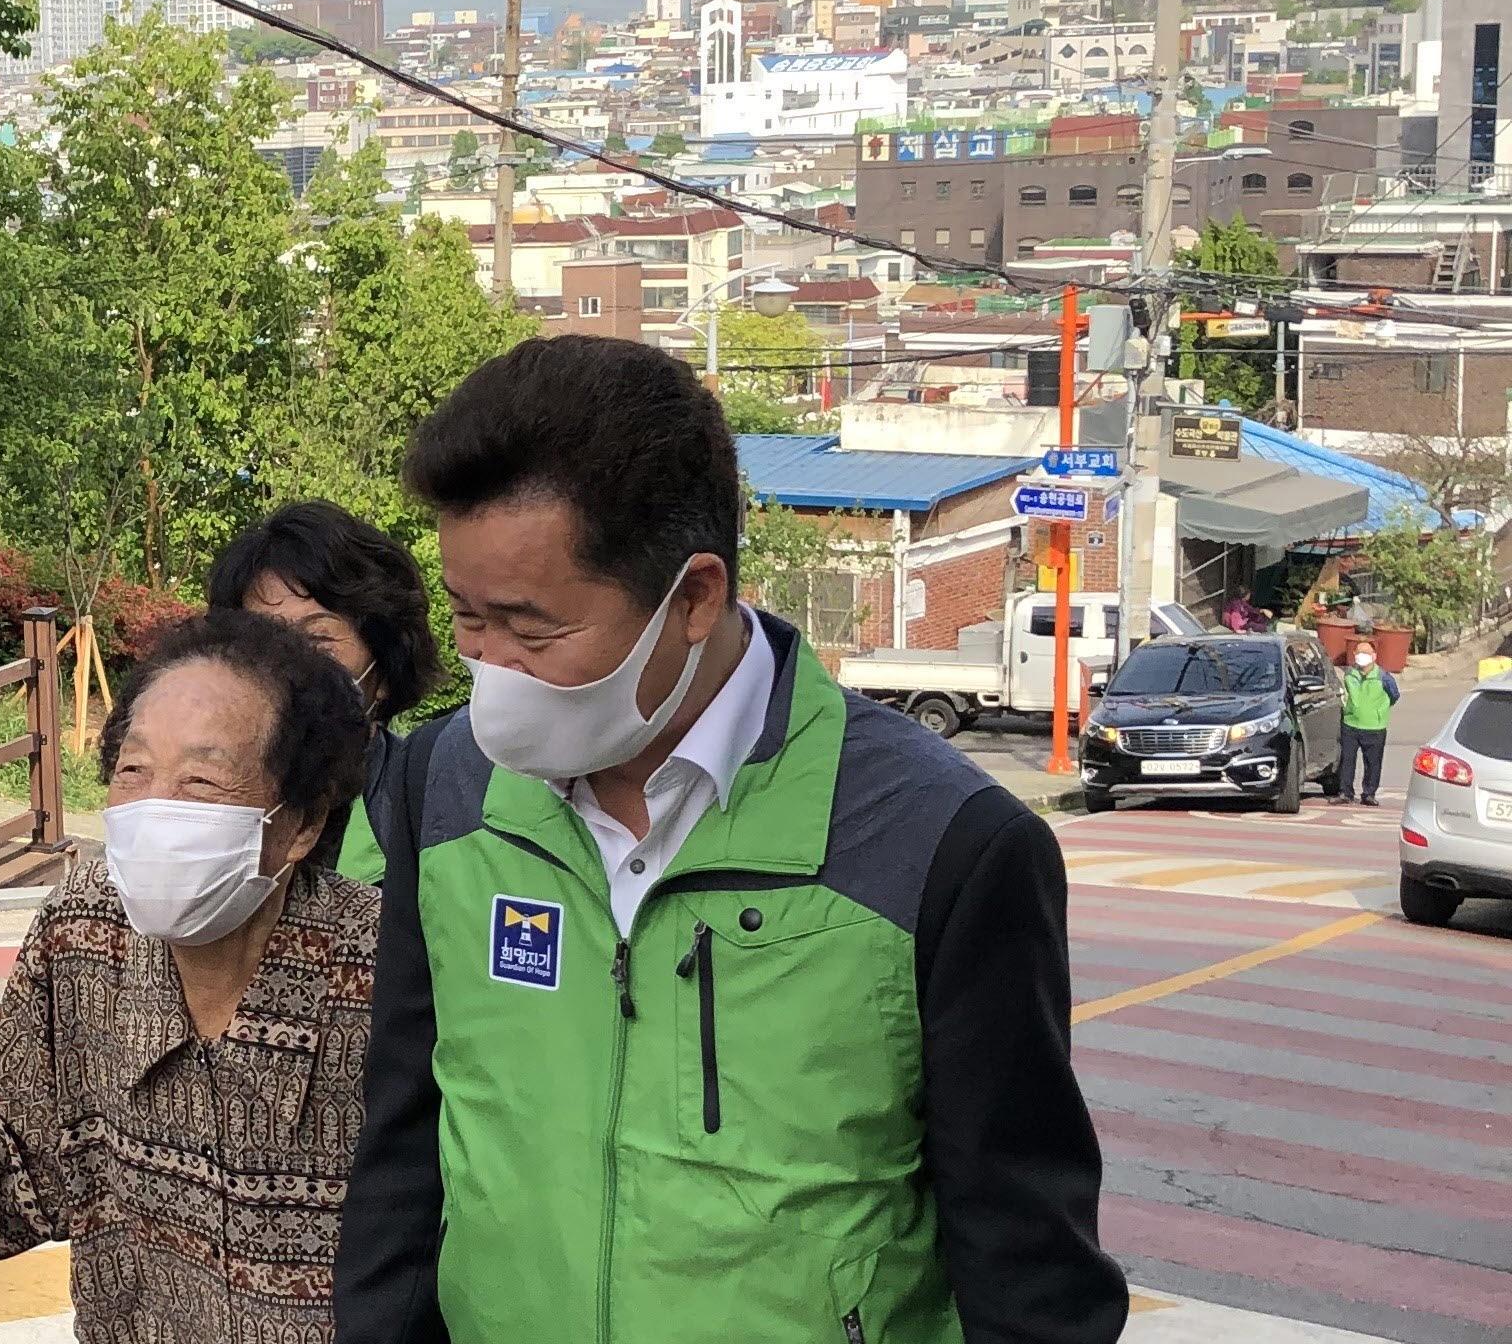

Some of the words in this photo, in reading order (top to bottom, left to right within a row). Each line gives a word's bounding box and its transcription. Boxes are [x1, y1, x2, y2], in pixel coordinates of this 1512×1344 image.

[899, 131, 1034, 161] 제삼교
[1061, 453, 1114, 469] 서부교회
[500, 937, 551, 969] 희망지기
[500, 961, 525, 971] Guardian
